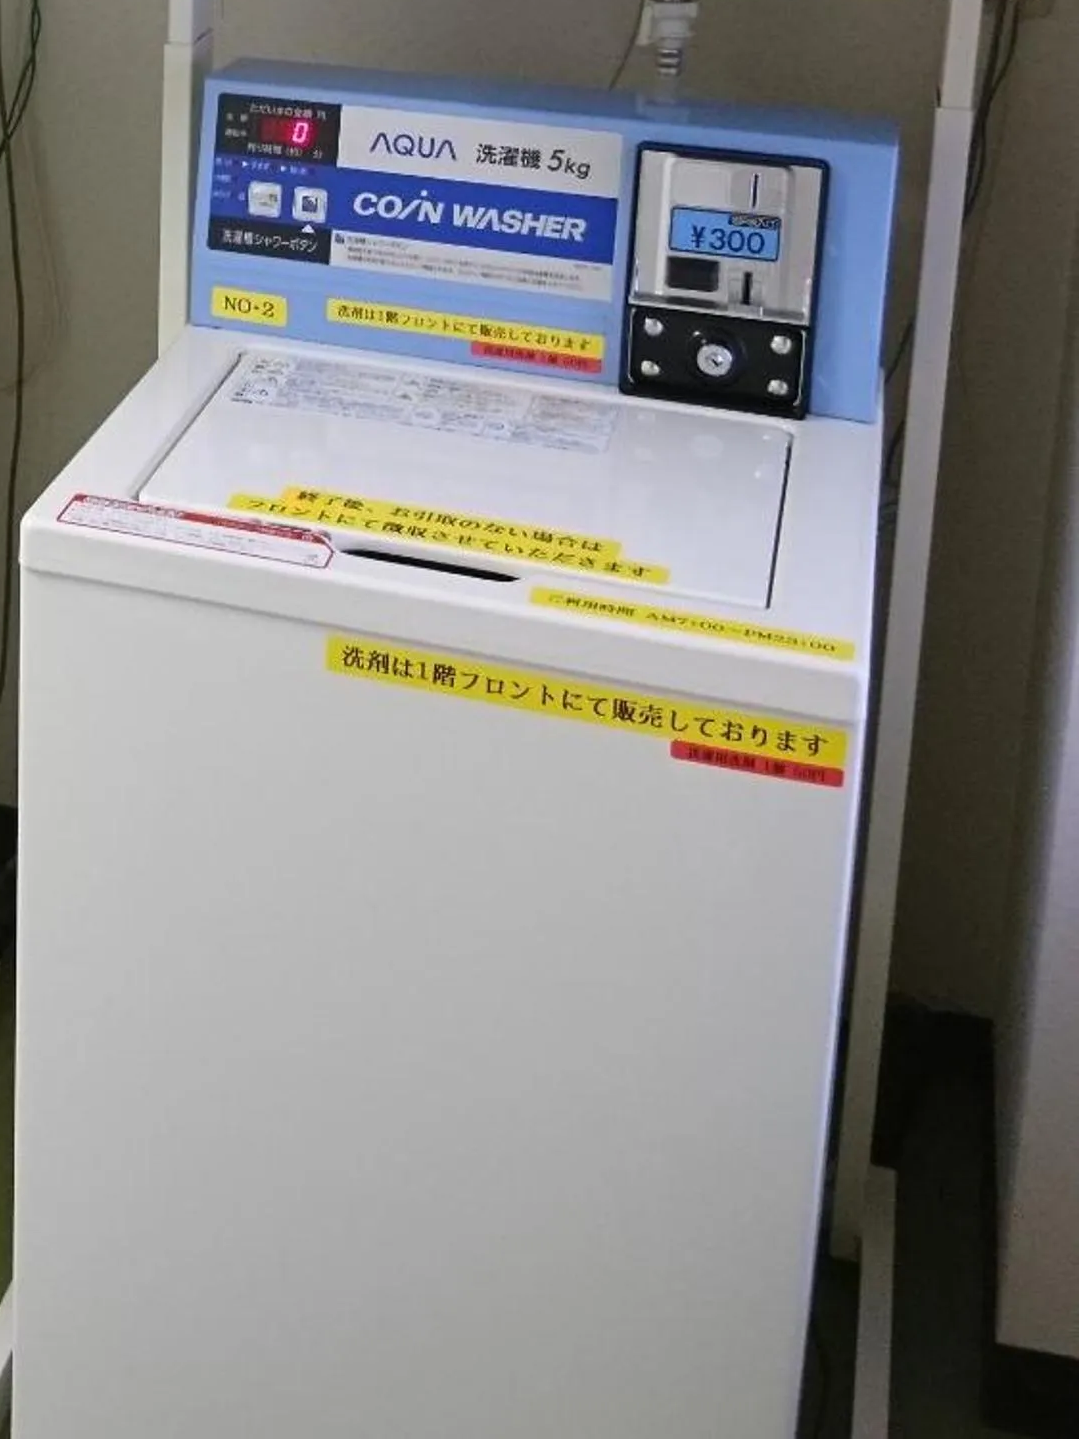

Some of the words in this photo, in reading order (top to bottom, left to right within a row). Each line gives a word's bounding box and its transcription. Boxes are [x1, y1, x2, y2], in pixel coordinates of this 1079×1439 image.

[291, 122, 309, 144] 0
[370, 131, 457, 162] AQUA
[476, 143, 542, 170] 洗濯機
[547, 149, 592, 180] 5kg
[453, 204, 588, 243] WASHER
[691, 224, 766, 255] ¥300
[341, 644, 829, 756] 洗剤は1階フロントにて販売しております
